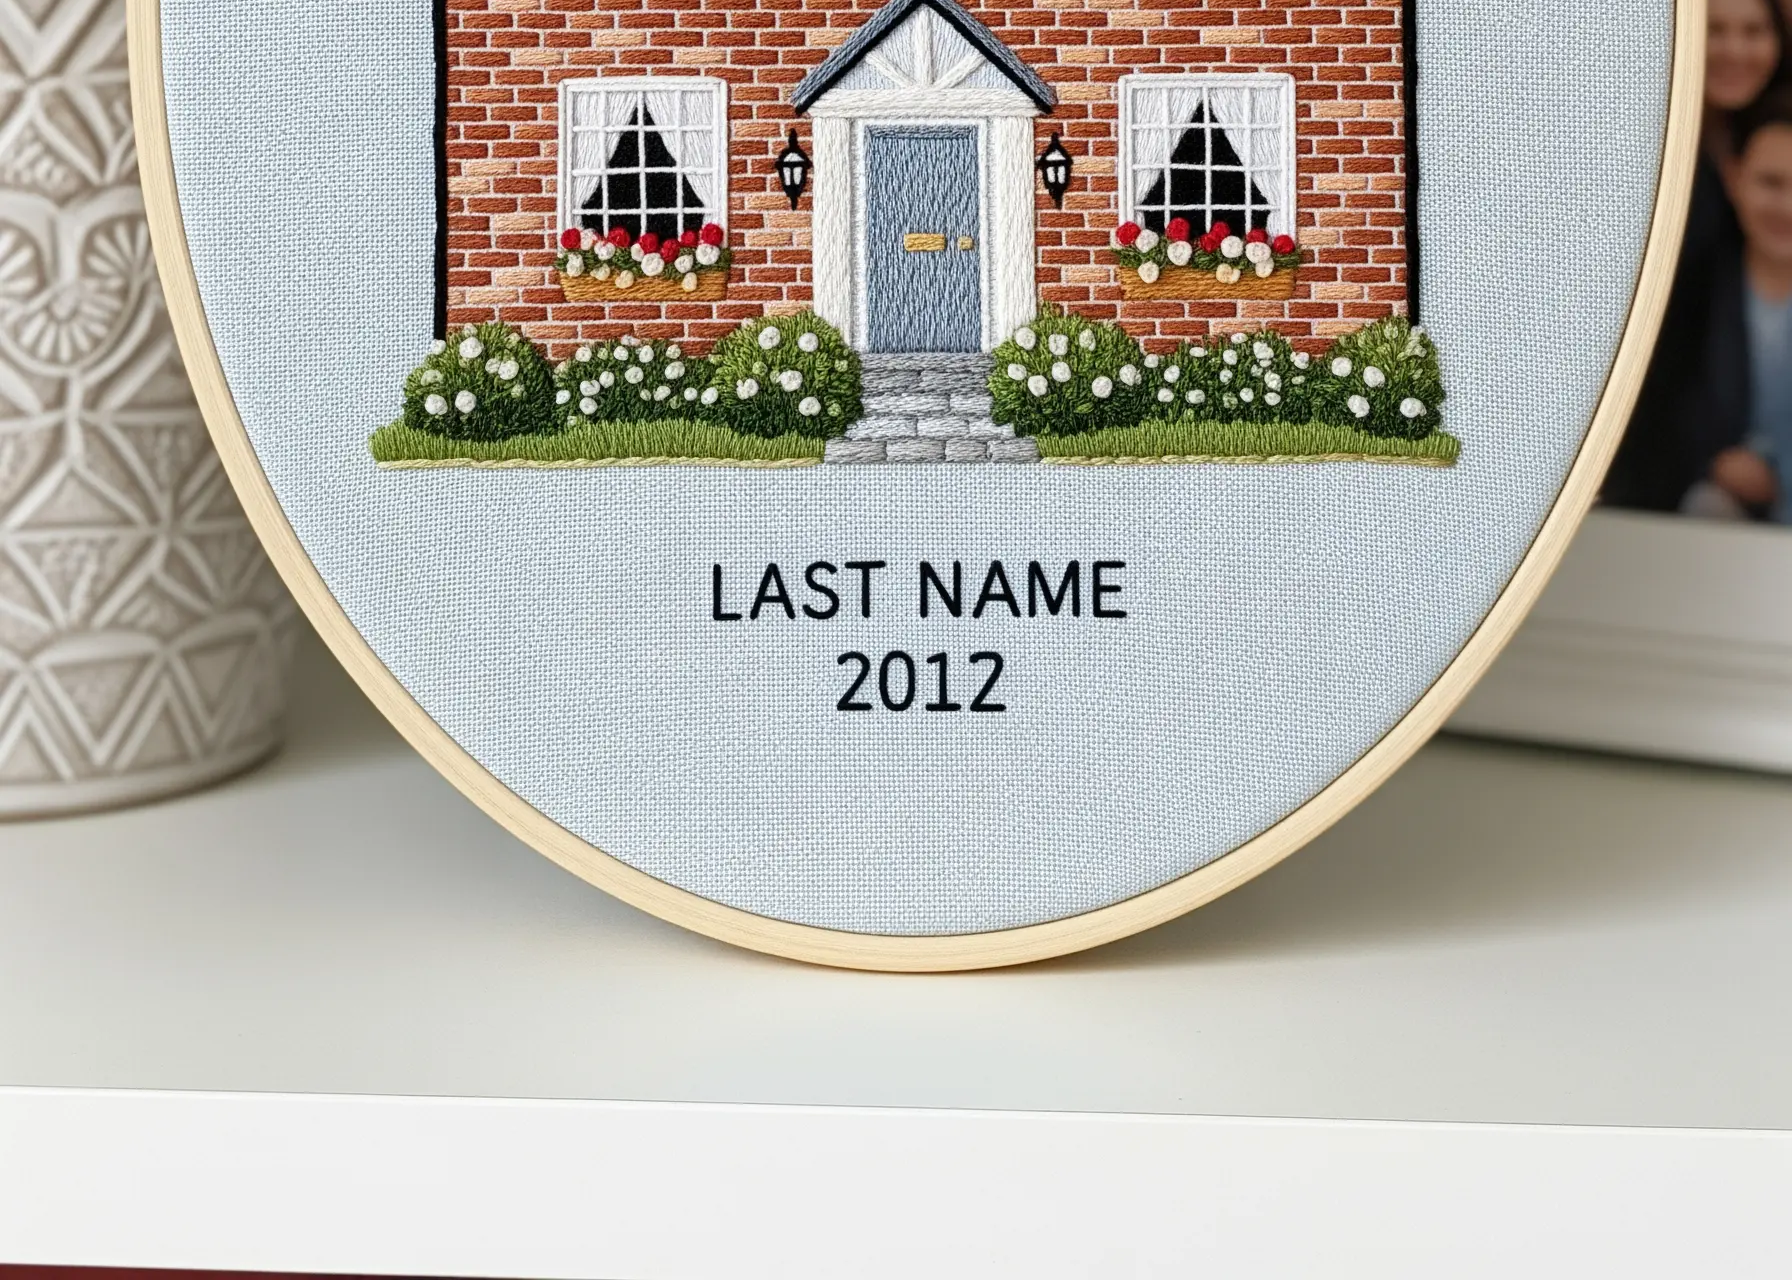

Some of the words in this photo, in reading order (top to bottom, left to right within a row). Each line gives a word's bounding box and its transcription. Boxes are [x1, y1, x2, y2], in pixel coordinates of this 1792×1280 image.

[711, 559, 887, 622] LAST
[919, 559, 1128, 620] NAME
[836, 649, 1007, 713] 2012
